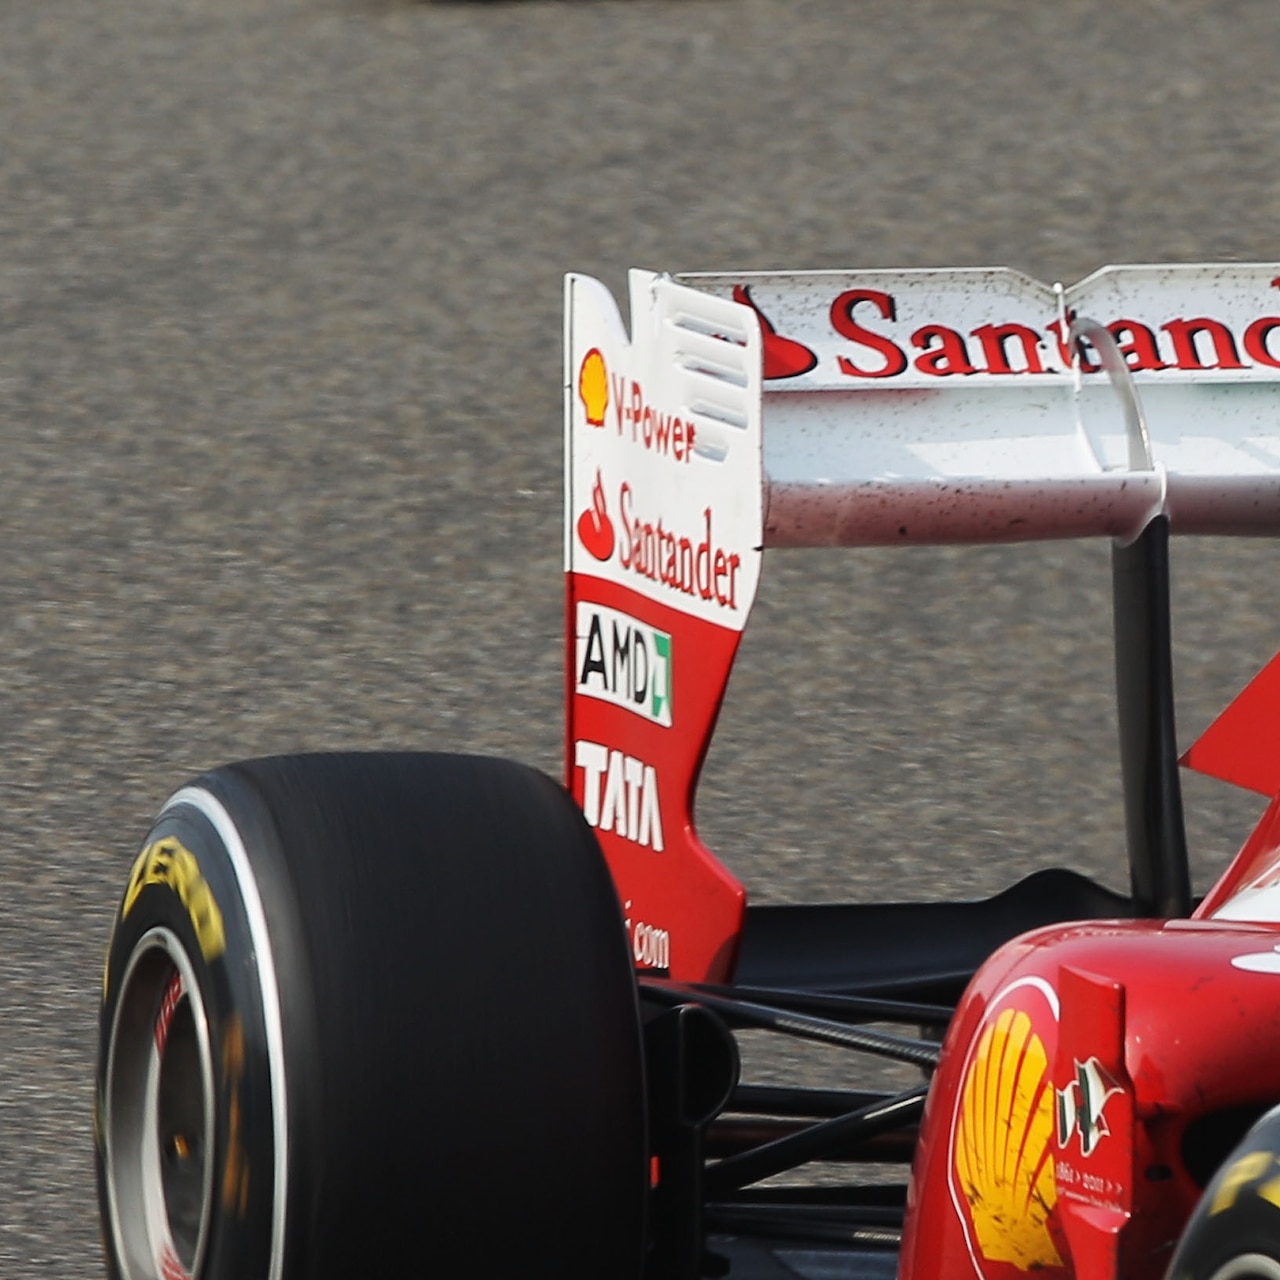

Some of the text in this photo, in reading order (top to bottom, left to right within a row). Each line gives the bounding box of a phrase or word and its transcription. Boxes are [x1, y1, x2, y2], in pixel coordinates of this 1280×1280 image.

[612, 372, 695, 464] V-Power
[619, 481, 740, 610] Santander
[580, 613, 648, 705] AMD
[575, 739, 664, 853] TATA
